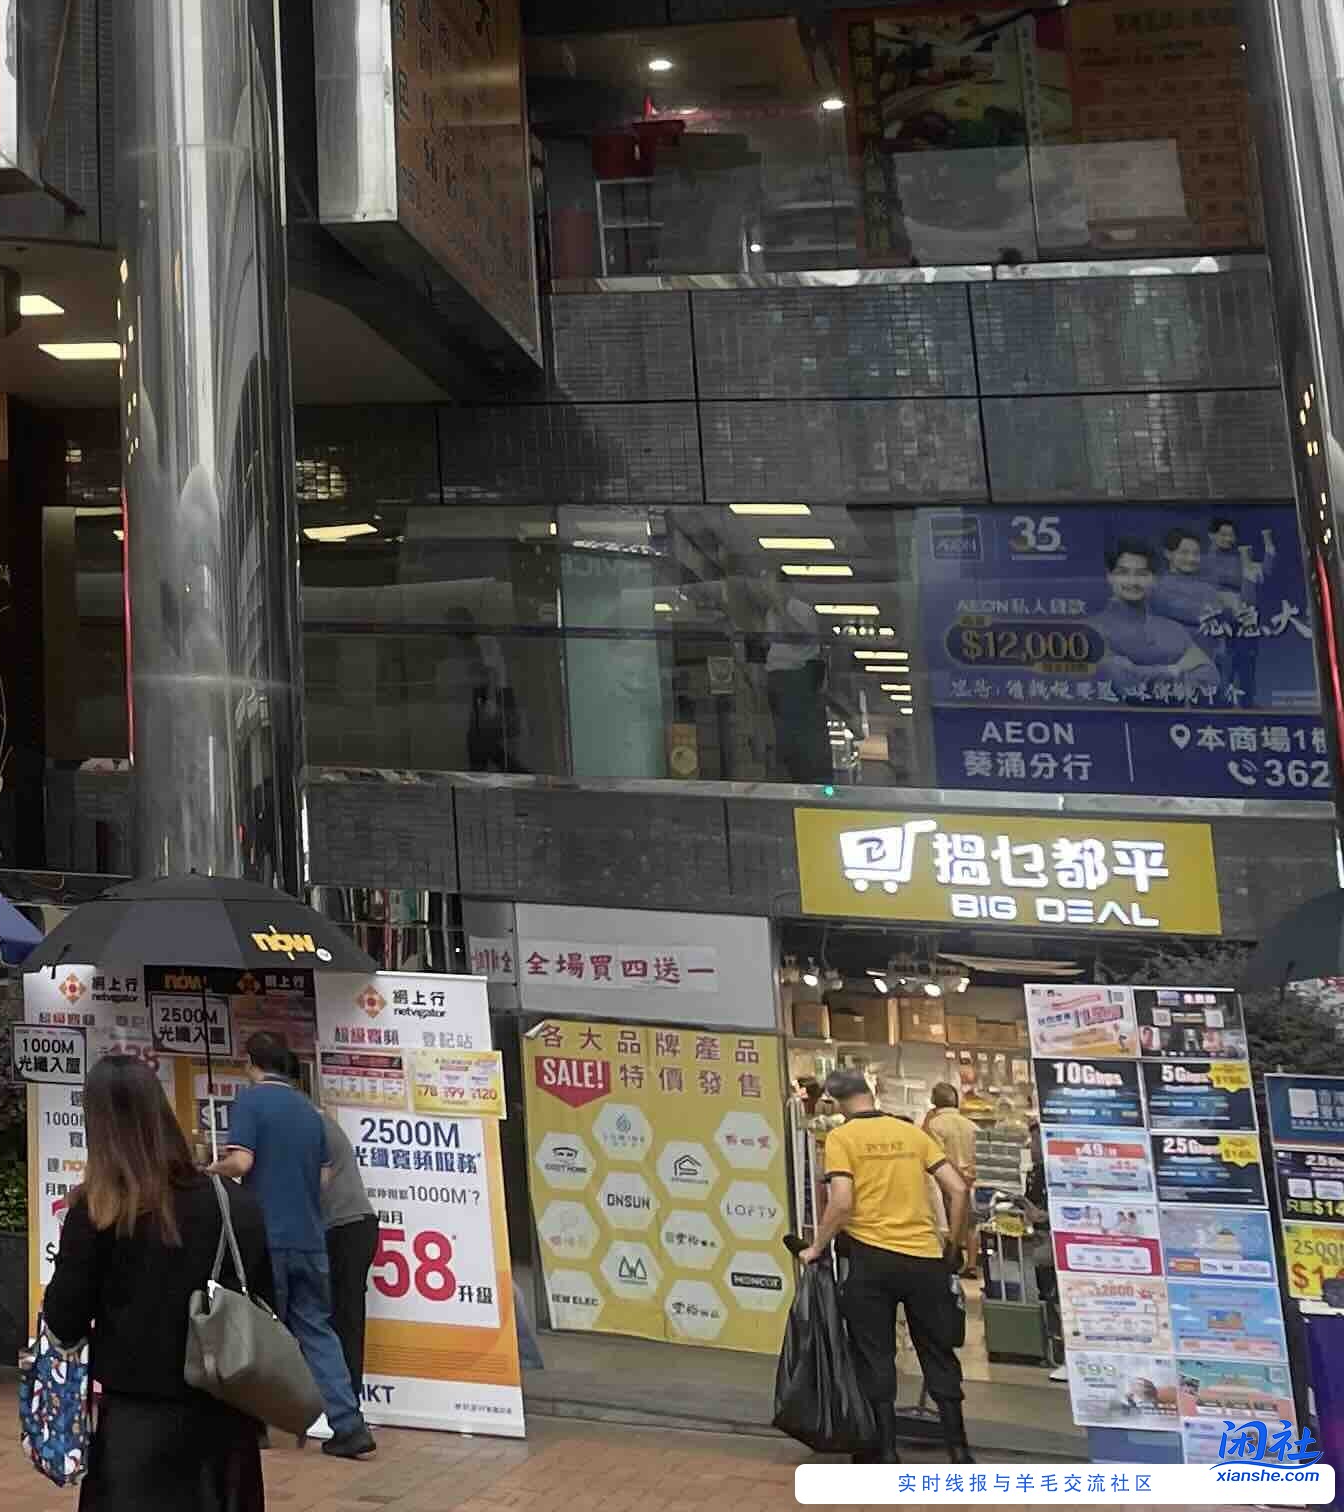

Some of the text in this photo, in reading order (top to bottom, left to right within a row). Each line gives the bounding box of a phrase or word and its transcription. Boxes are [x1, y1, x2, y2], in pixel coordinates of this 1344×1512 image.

[960, 630, 1090, 666] $12,000
[981, 721, 1076, 746] AEON
[962, 749, 1093, 782] 葵涌分行
[950, 893, 1160, 928] BIG DEAL
[524, 951, 717, 984] 全場買四送一
[21, 1037, 75, 1054] 1000M
[538, 1025, 761, 1065] 各大品牌產品
[541, 1058, 607, 1090] SALE!
[619, 1063, 763, 1100] 特價發售
[359, 1117, 461, 1149] 2500M
